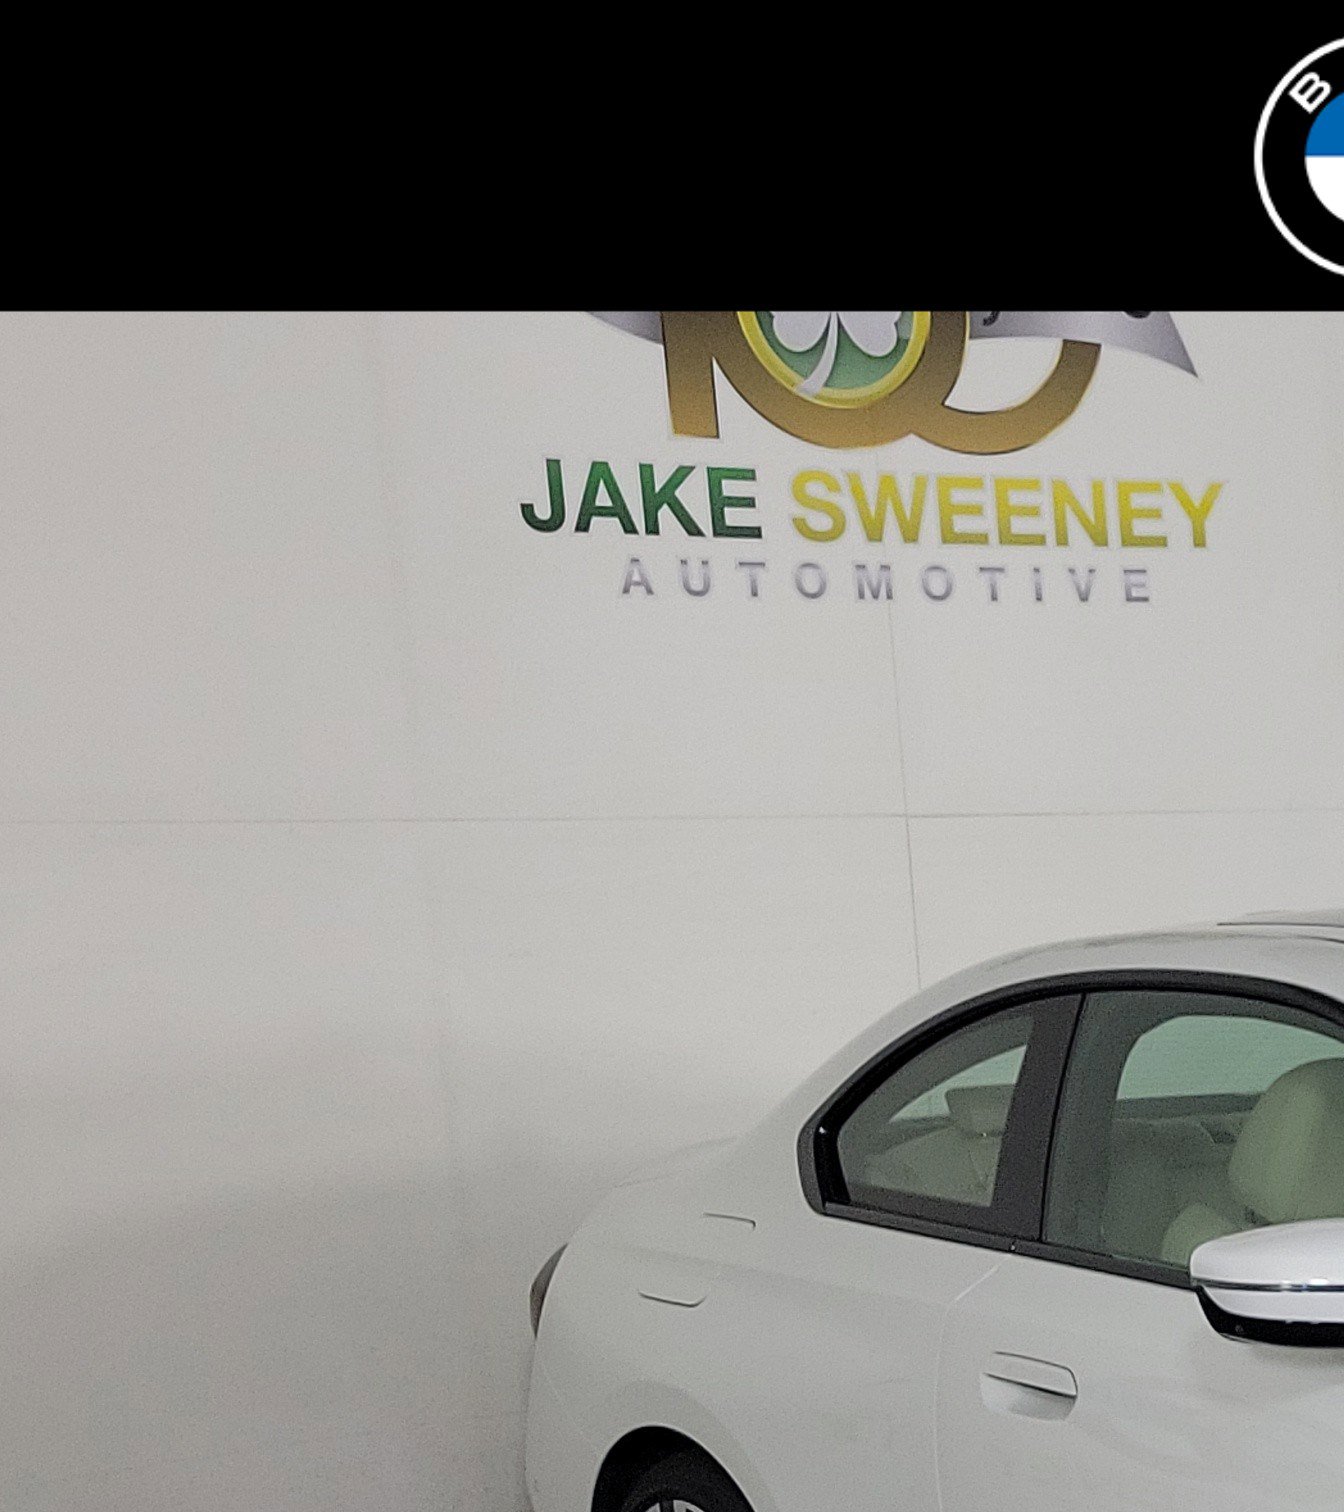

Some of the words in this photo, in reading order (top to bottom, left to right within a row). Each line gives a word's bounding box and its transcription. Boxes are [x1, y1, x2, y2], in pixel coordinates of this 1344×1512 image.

[520, 458, 763, 540] JAKE
[789, 468, 1225, 549] SWEENEY
[621, 557, 1152, 604] AUTOMOTIVE
